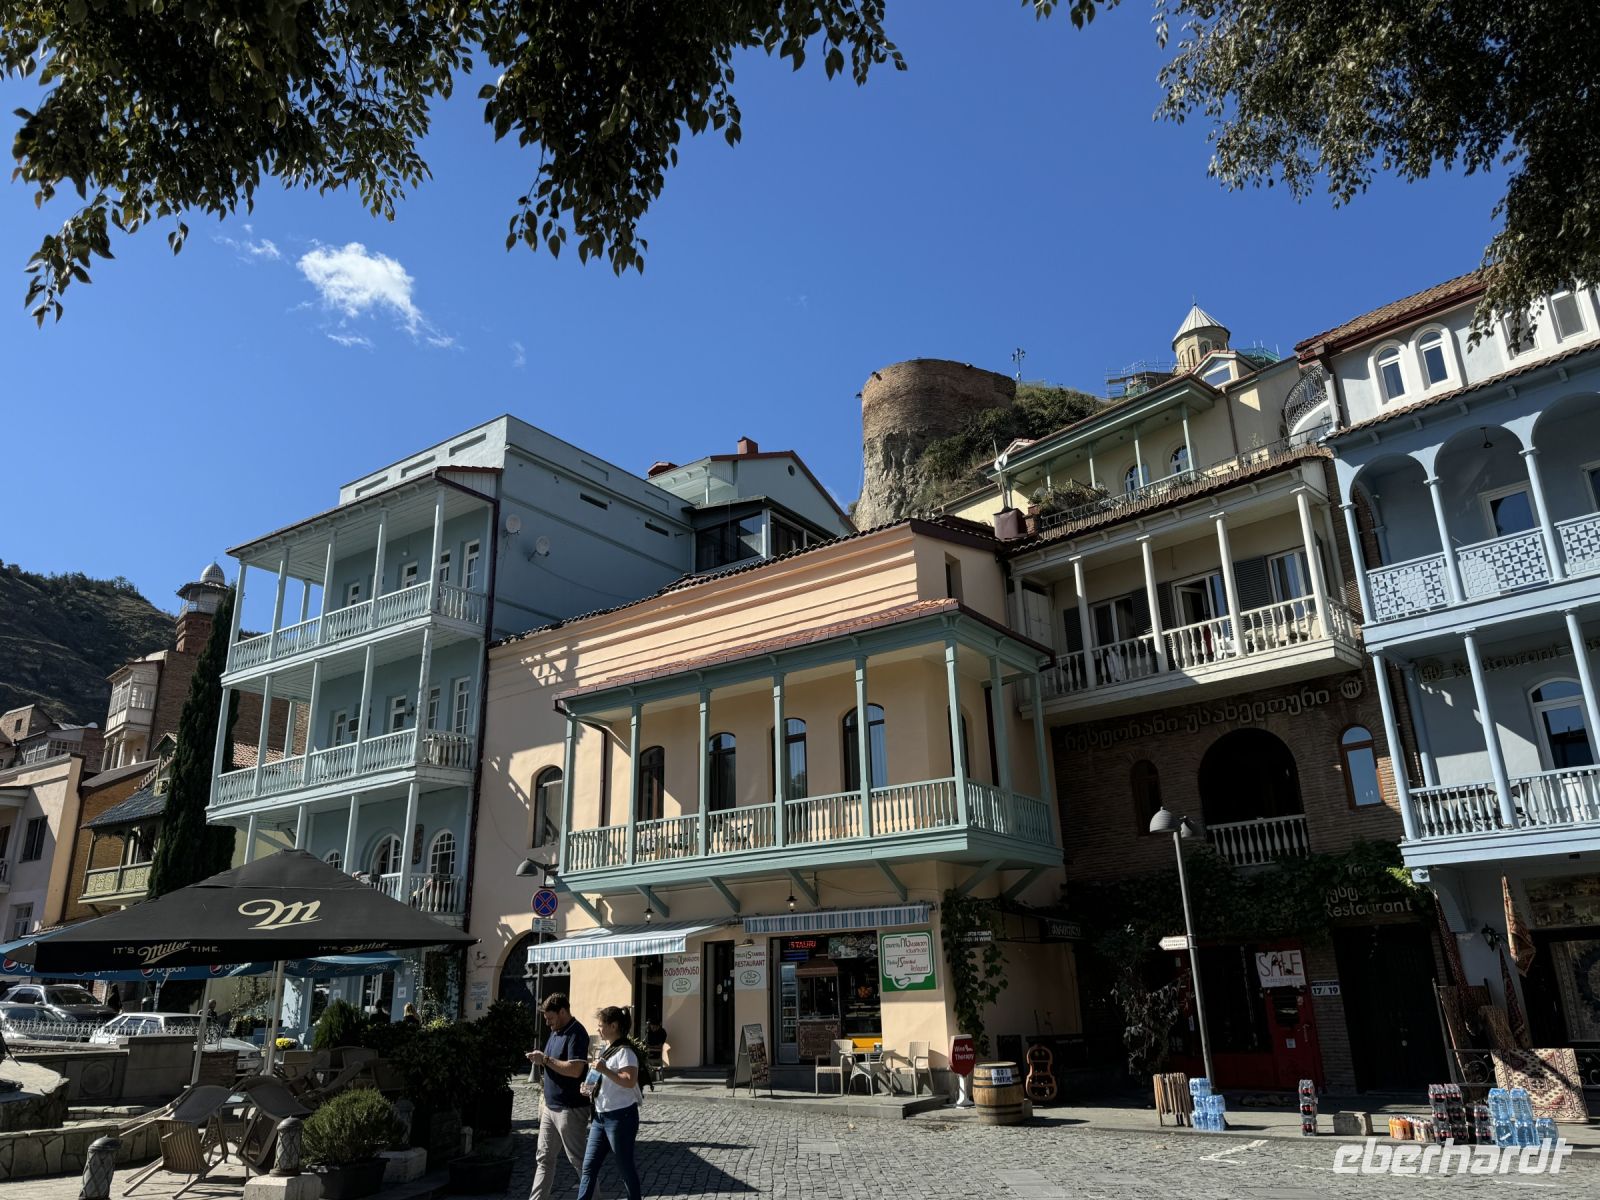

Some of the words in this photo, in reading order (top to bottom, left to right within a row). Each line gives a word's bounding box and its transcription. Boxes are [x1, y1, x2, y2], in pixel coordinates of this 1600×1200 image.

[1064, 714, 1180, 753] რესტორანი
[113, 946, 135, 955] IT'S
[137, 941, 191, 965] Miller
[735, 960, 765, 968] RESTAURANT
[1259, 953, 1303, 976] SALE
